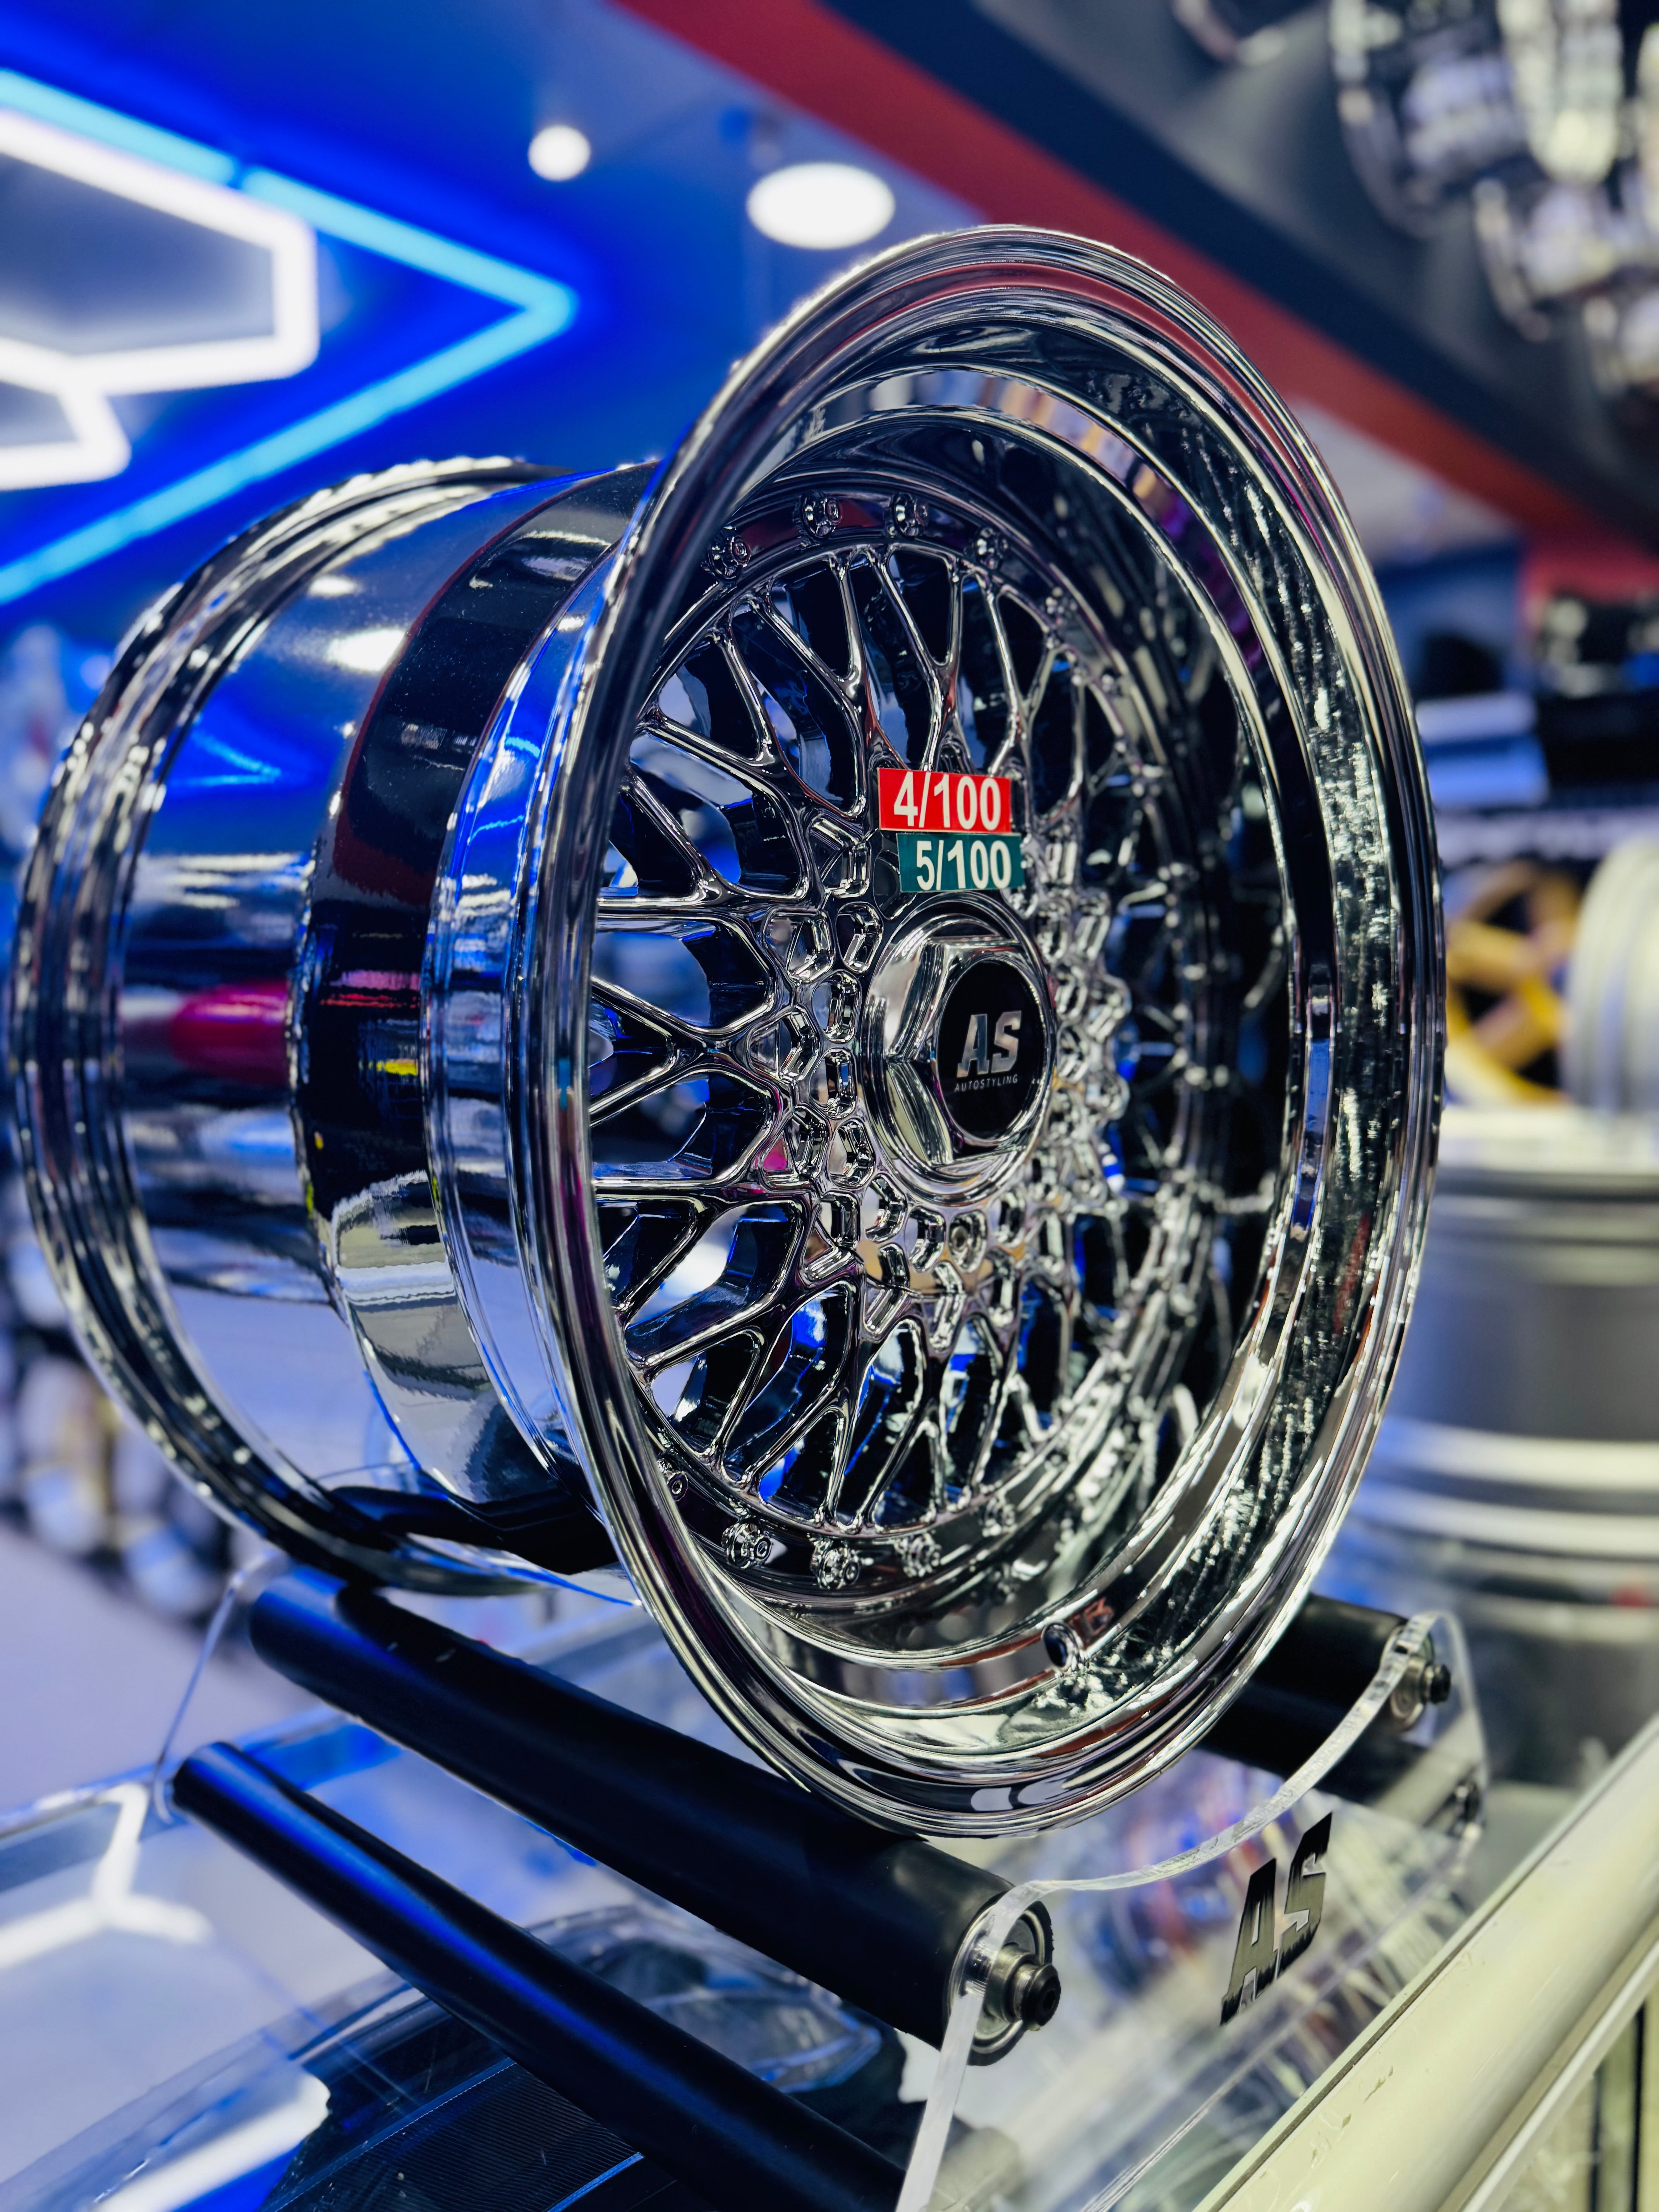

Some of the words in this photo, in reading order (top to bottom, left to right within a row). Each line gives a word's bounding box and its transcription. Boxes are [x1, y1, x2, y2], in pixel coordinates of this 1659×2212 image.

[894, 772, 1000, 830] 4/100
[917, 840, 1012, 890] 5/100
[957, 1011, 1022, 1077] AS
[955, 1075, 1018, 1092] AUTOSTYLING
[1220, 1812, 1332, 2027] AS
